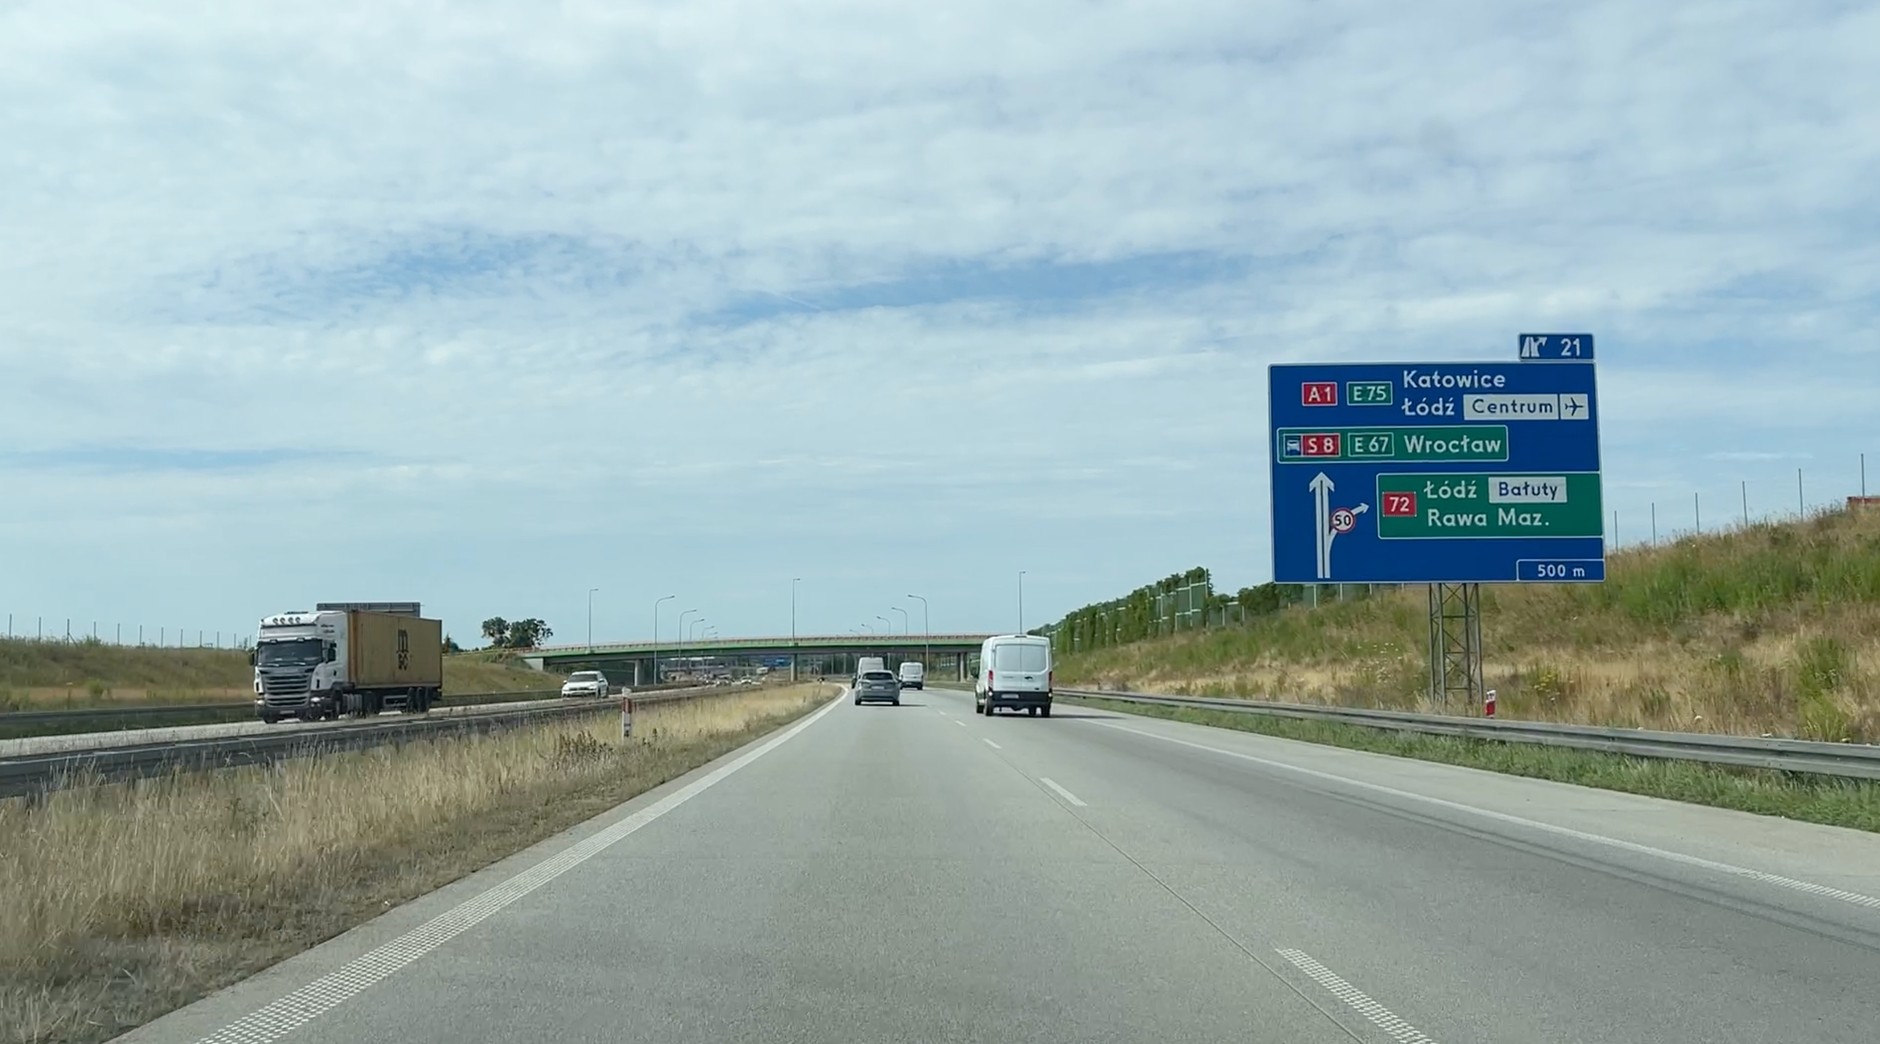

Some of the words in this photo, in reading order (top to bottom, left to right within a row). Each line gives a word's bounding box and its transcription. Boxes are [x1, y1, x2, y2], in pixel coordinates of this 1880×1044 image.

[1561, 338, 1581, 356] 21
[1403, 370, 1506, 389] Katowice
[1401, 395, 1455, 416] Łódź
[1472, 399, 1553, 414] Centrum
[1404, 435, 1501, 453] Wrocław
[1424, 478, 1477, 498] Łódź
[1499, 482, 1558, 500] Bałuty
[1389, 497, 1410, 512] 72
[1334, 514, 1351, 526] 50
[1428, 509, 1487, 526] Rawa
[1498, 508, 1549, 526] Maz.
[1538, 565, 1566, 577] 500
[1573, 567, 1585, 577] m
